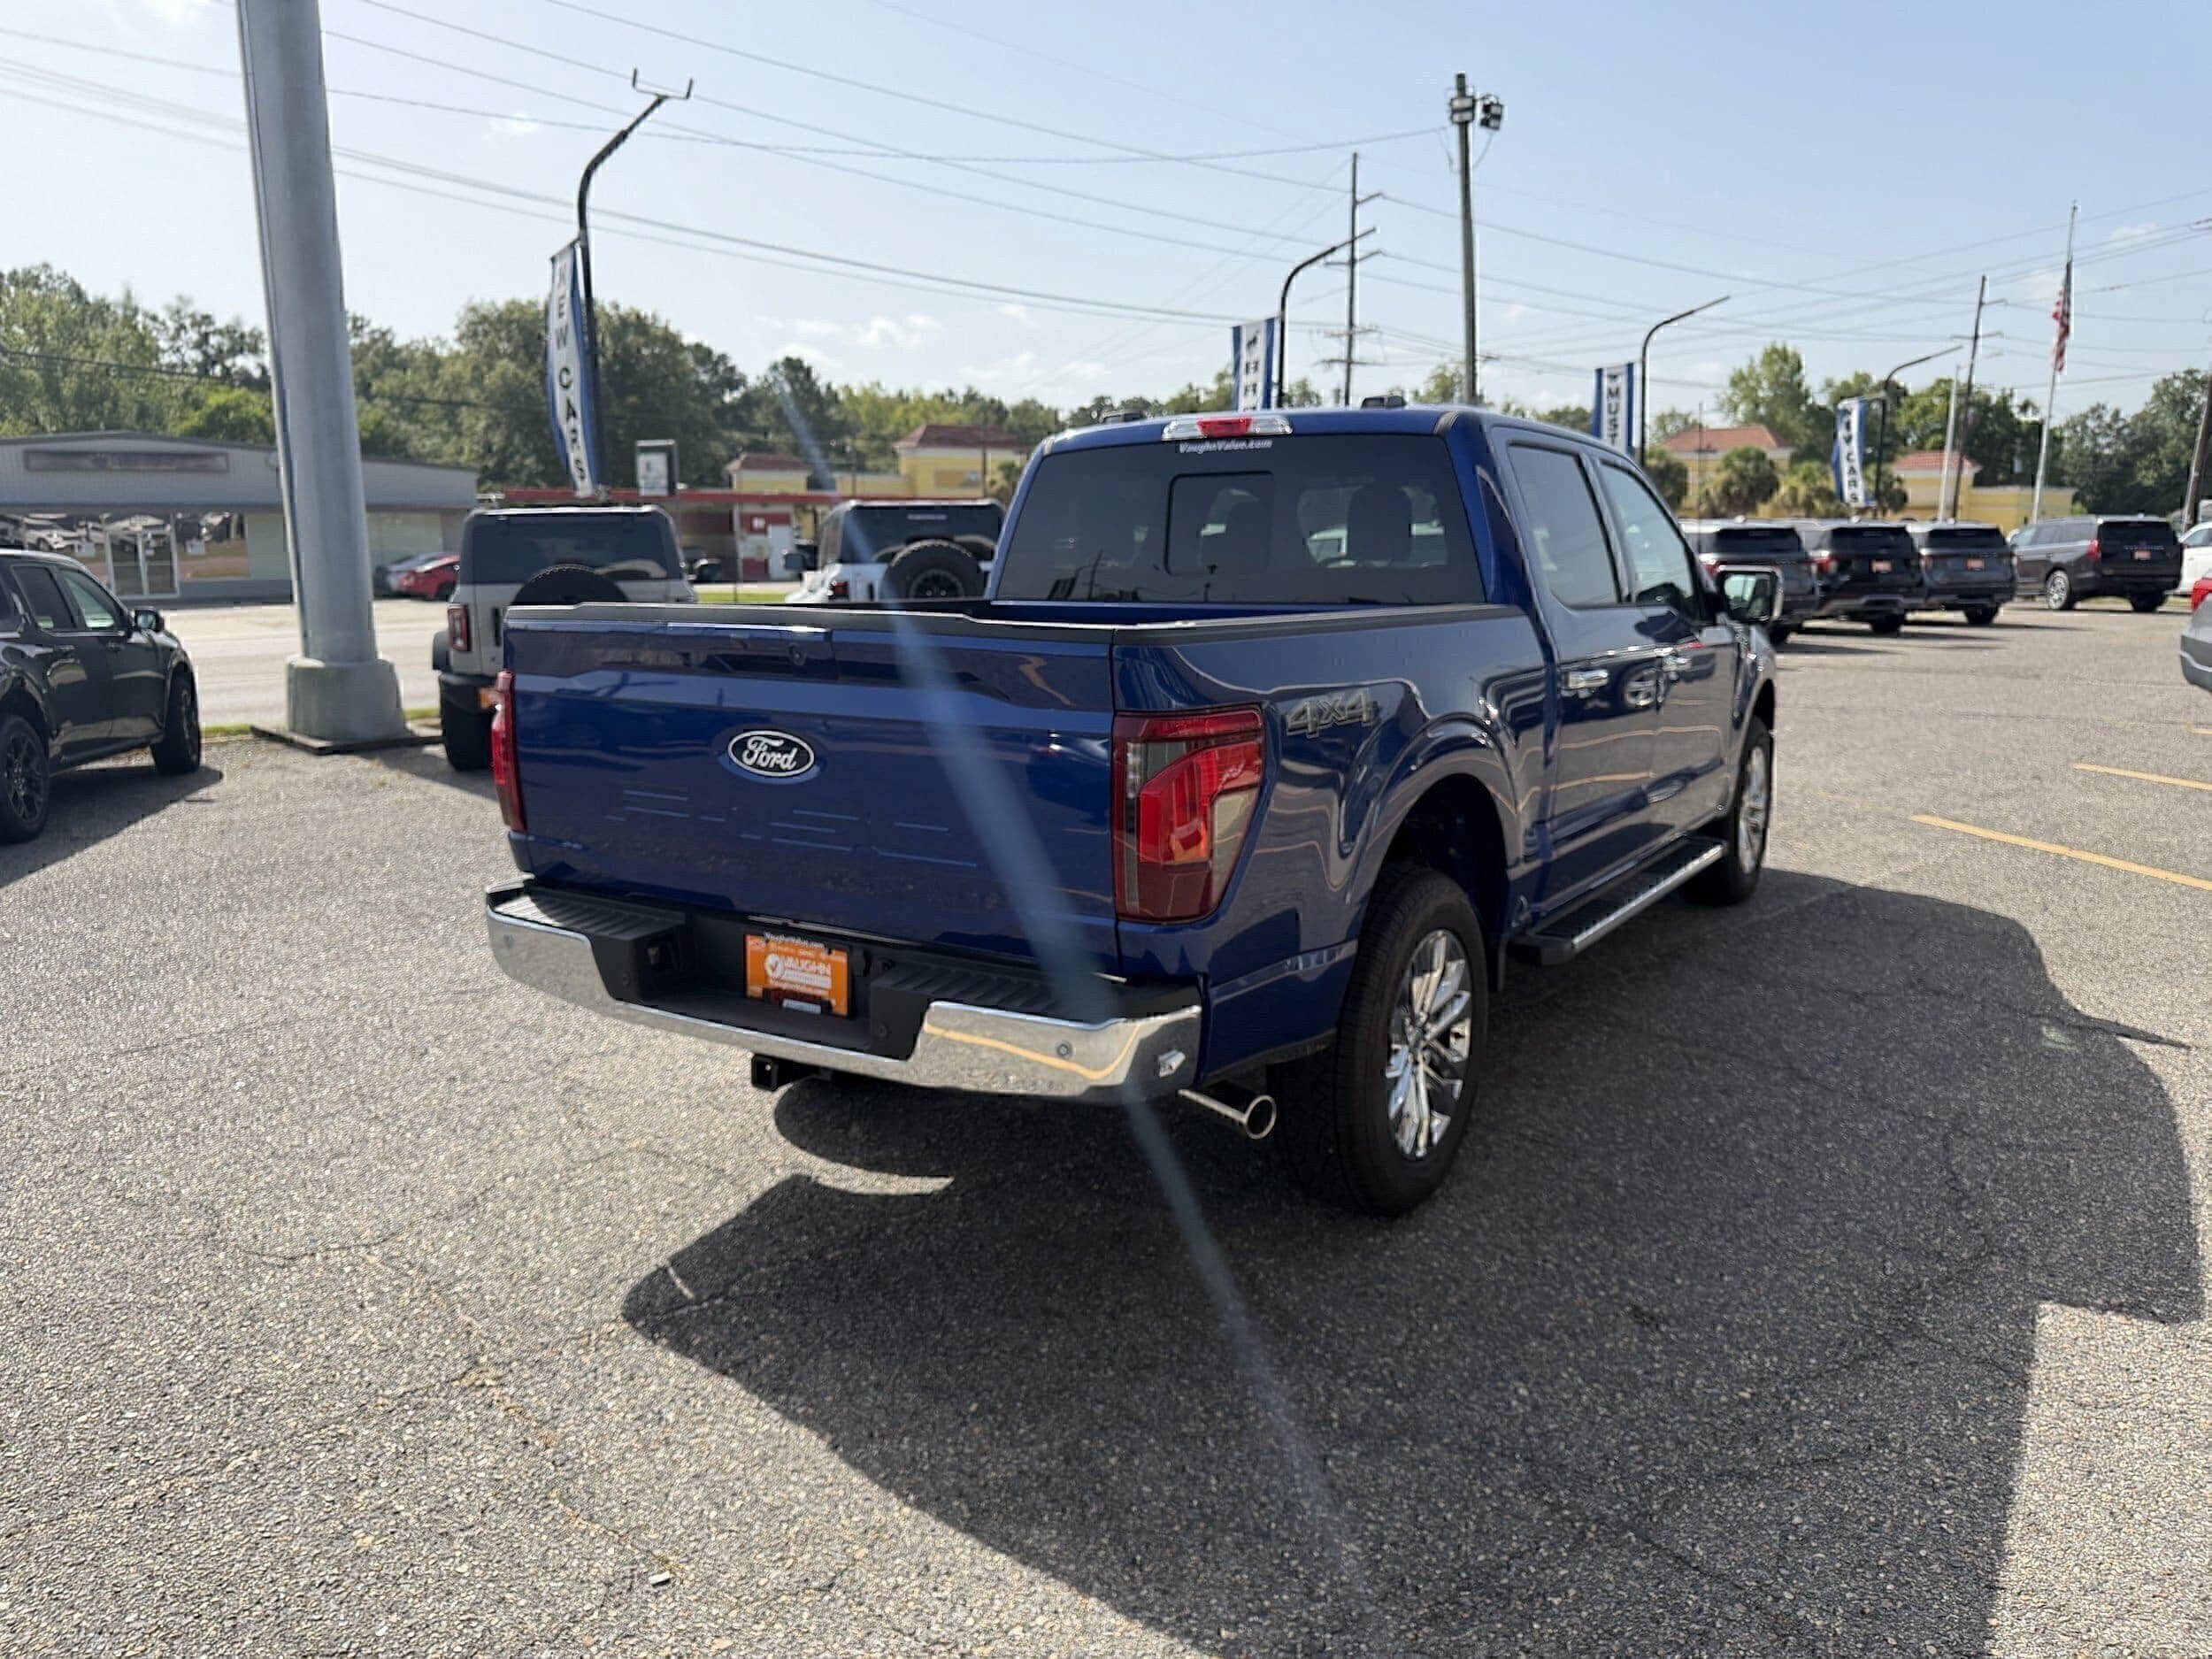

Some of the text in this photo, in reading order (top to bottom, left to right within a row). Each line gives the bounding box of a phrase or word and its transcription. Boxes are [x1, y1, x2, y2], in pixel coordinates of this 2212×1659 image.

[558, 365, 586, 481] CARS
[1286, 687, 1375, 739] 4x4
[741, 735, 798, 771] Ford
